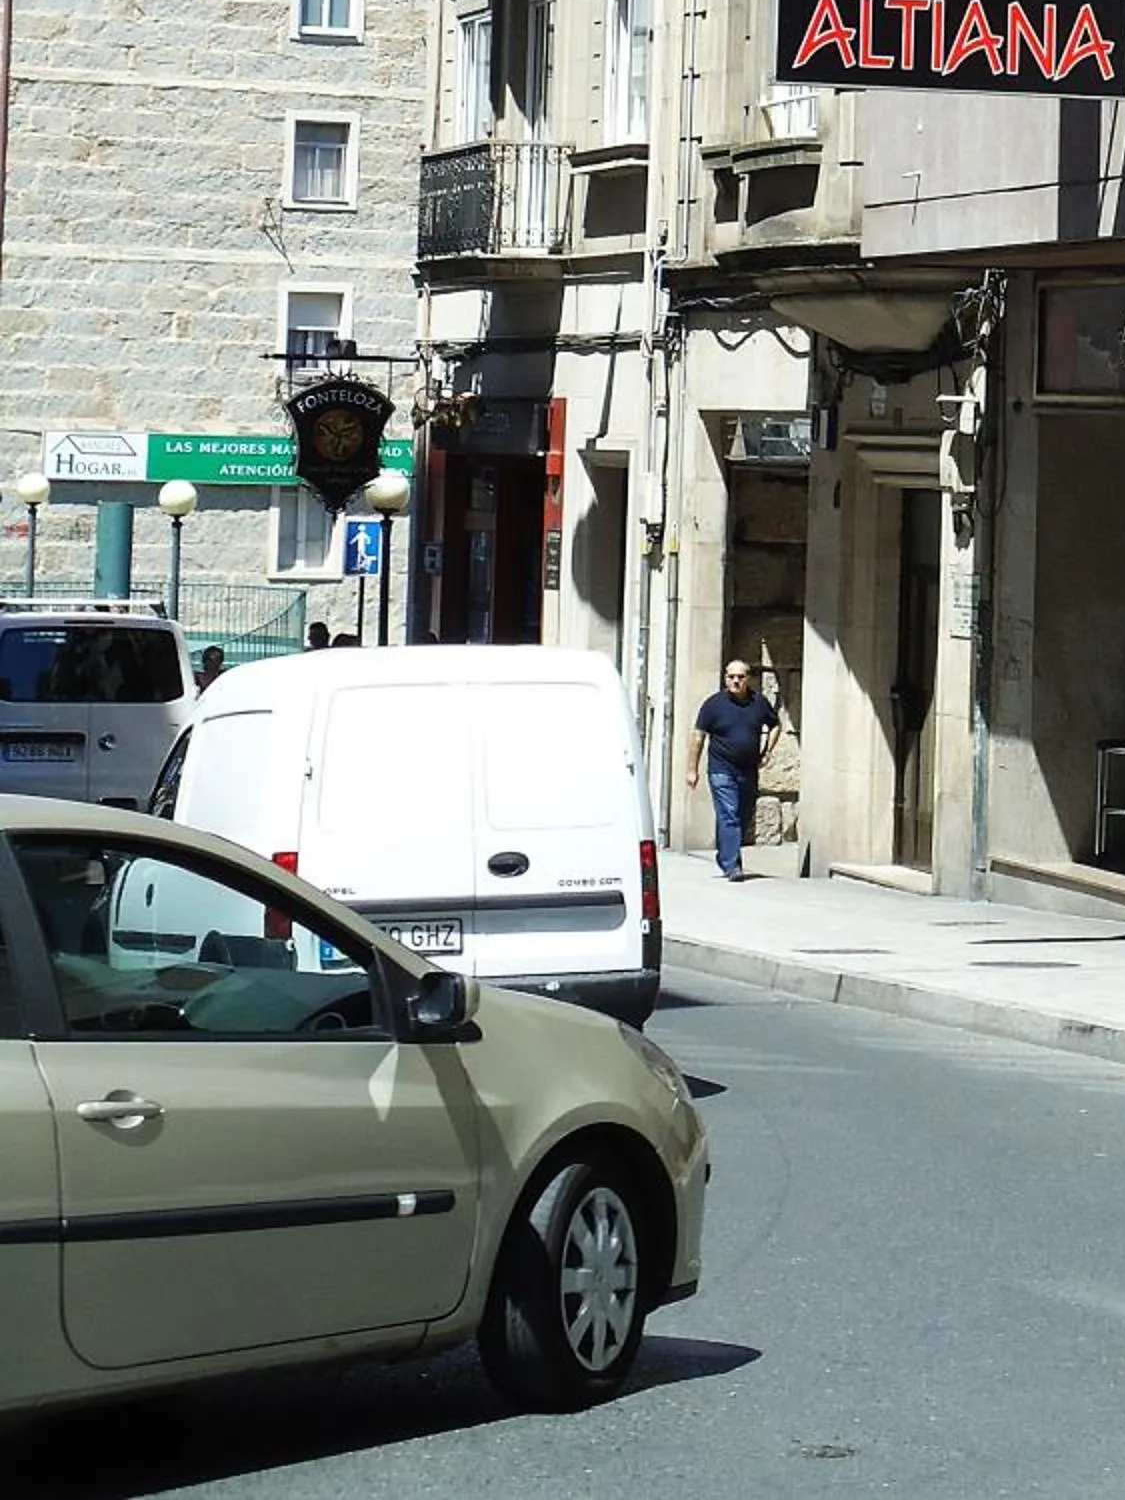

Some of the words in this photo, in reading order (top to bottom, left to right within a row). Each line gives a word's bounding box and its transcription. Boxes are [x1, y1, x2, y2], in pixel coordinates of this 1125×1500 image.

[165, 442, 193, 454] LAS
[199, 443, 267, 456] MEJORES
[411, 924, 456, 947] GHZ
